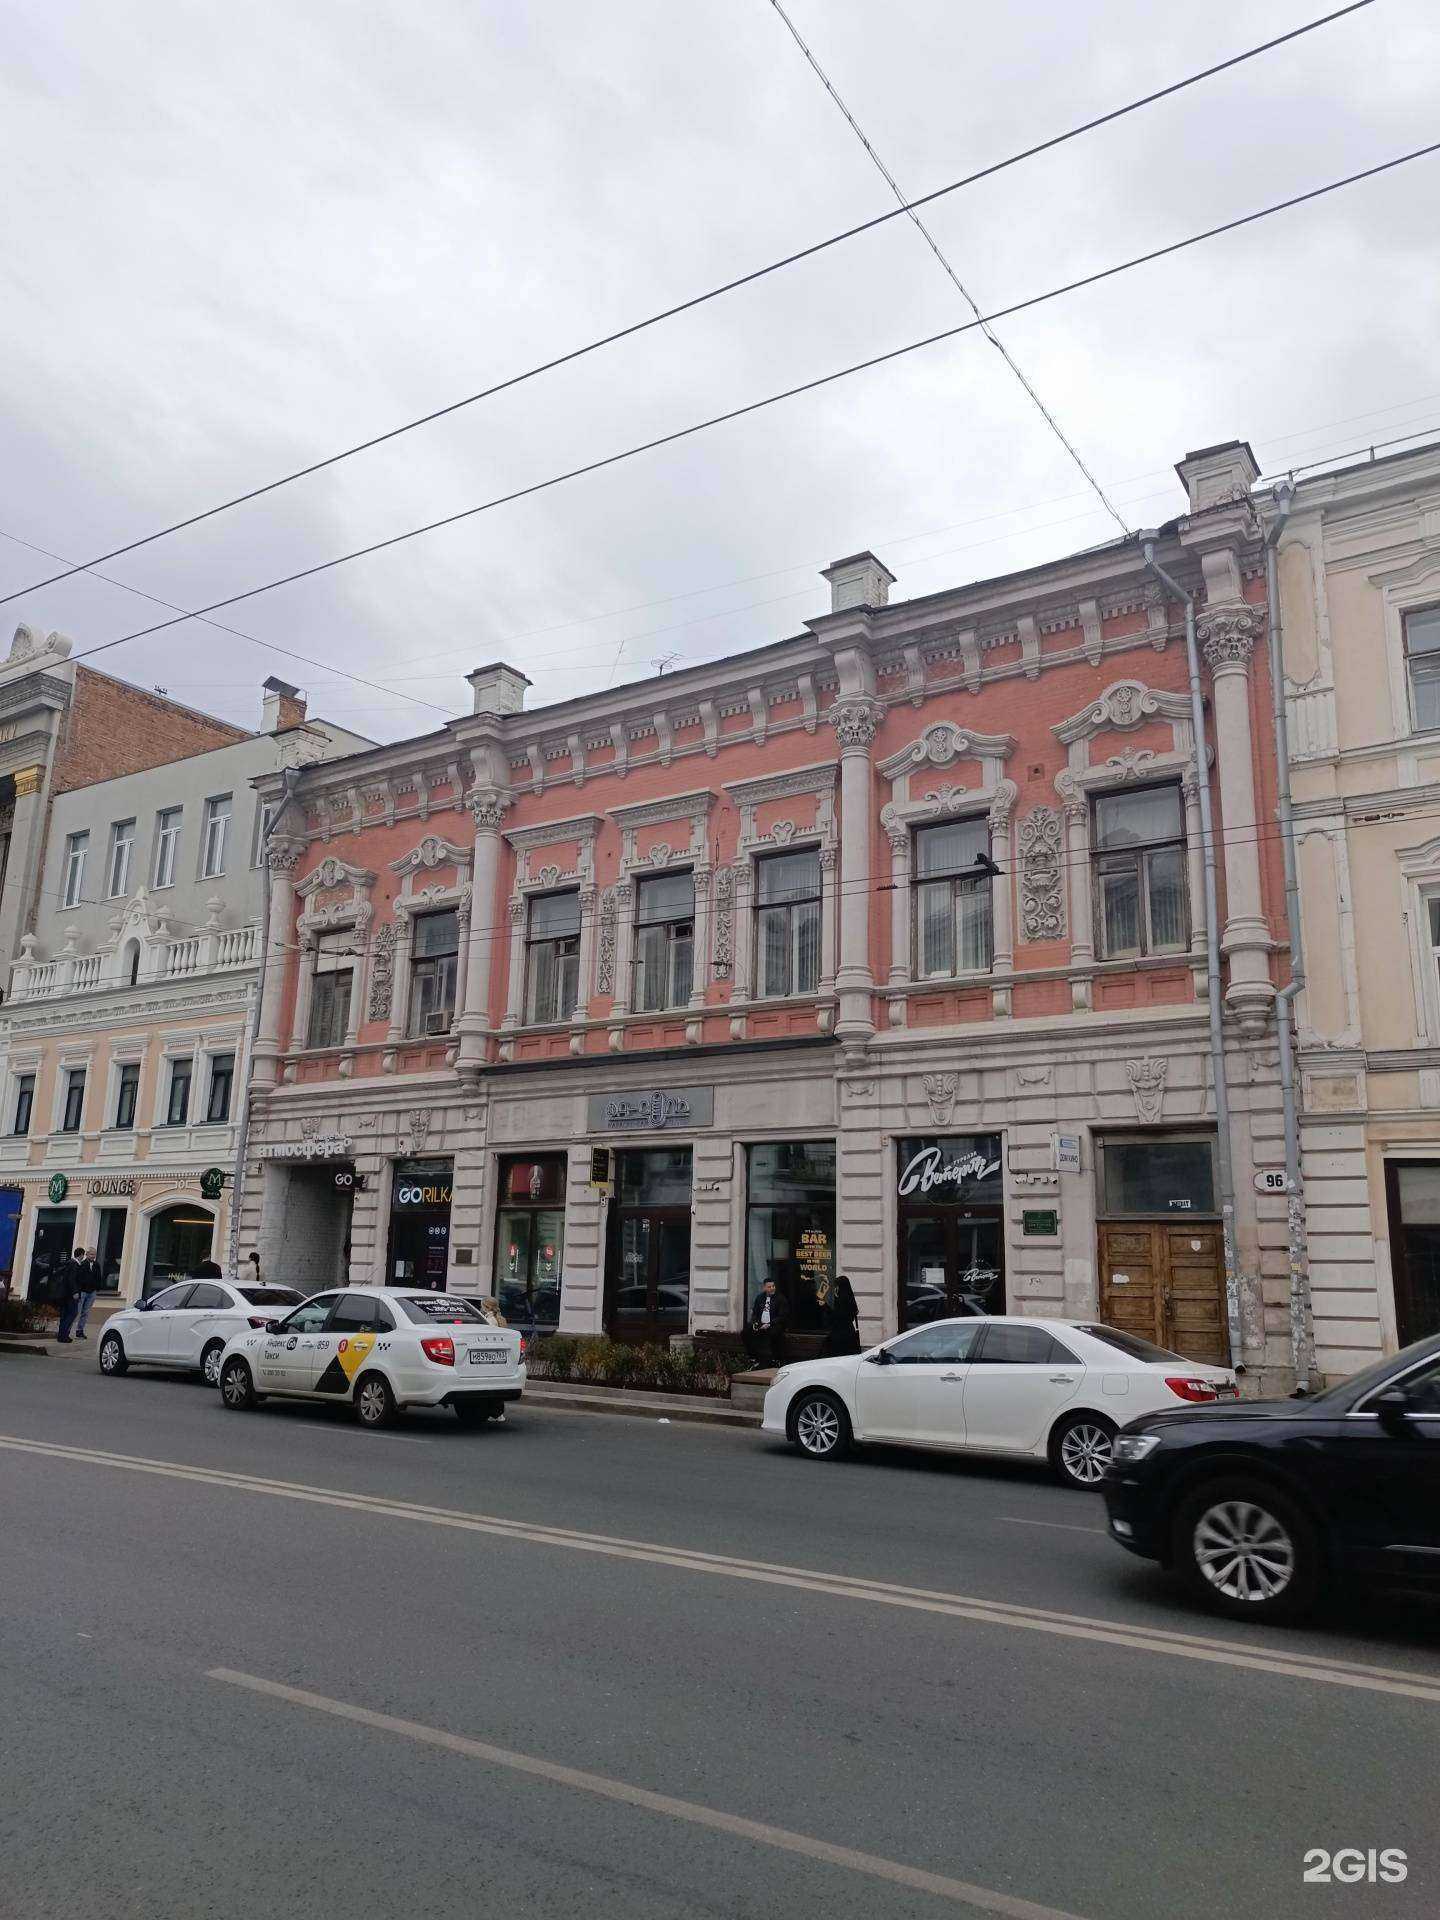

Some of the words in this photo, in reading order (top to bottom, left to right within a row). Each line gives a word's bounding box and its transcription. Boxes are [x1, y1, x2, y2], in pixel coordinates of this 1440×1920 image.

[335, 1173, 353, 1186] GO
[1266, 1174, 1284, 1187] 96
[86, 1179, 135, 1196] LOUNGE
[801, 1233, 827, 1245] BAR
[800, 1263, 828, 1271] WORLD
